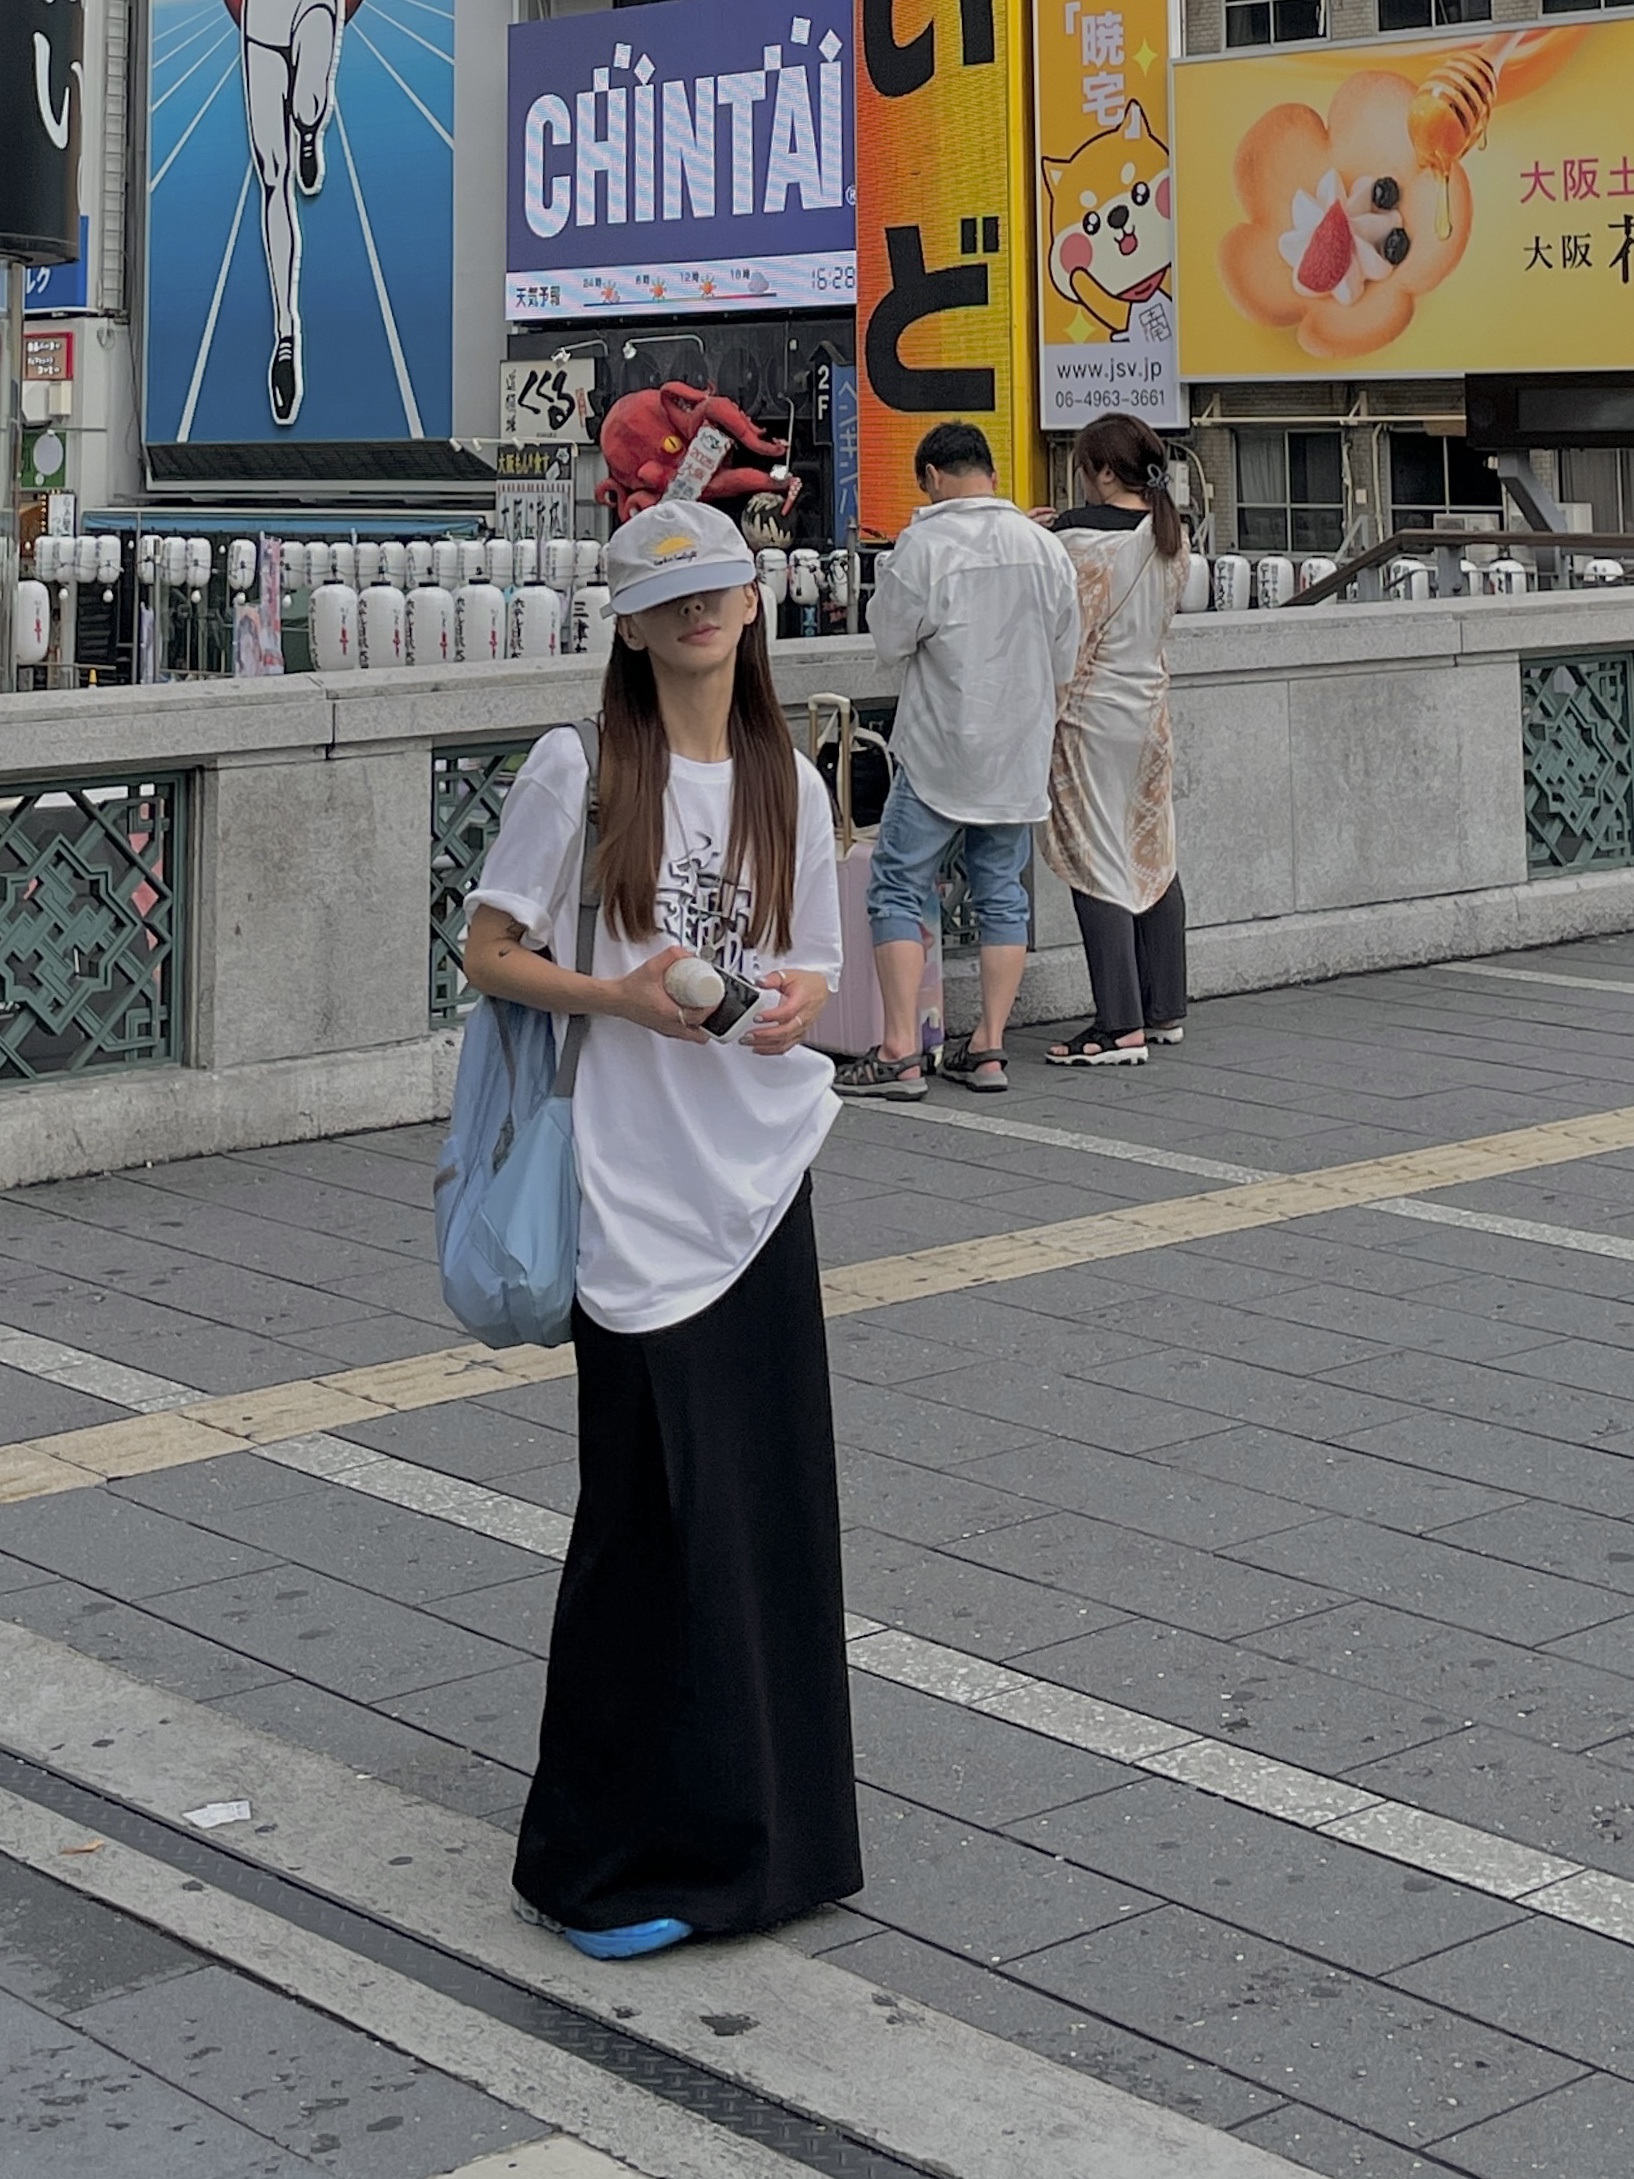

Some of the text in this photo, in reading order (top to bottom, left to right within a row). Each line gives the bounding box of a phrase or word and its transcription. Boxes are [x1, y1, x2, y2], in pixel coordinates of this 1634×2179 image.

[810, 265, 856, 291] 16:28
[515, 286, 561, 308] 天気予報
[1057, 356, 1162, 382] www.jsv.jp
[1055, 389, 1165, 408] 06-4963-3661
